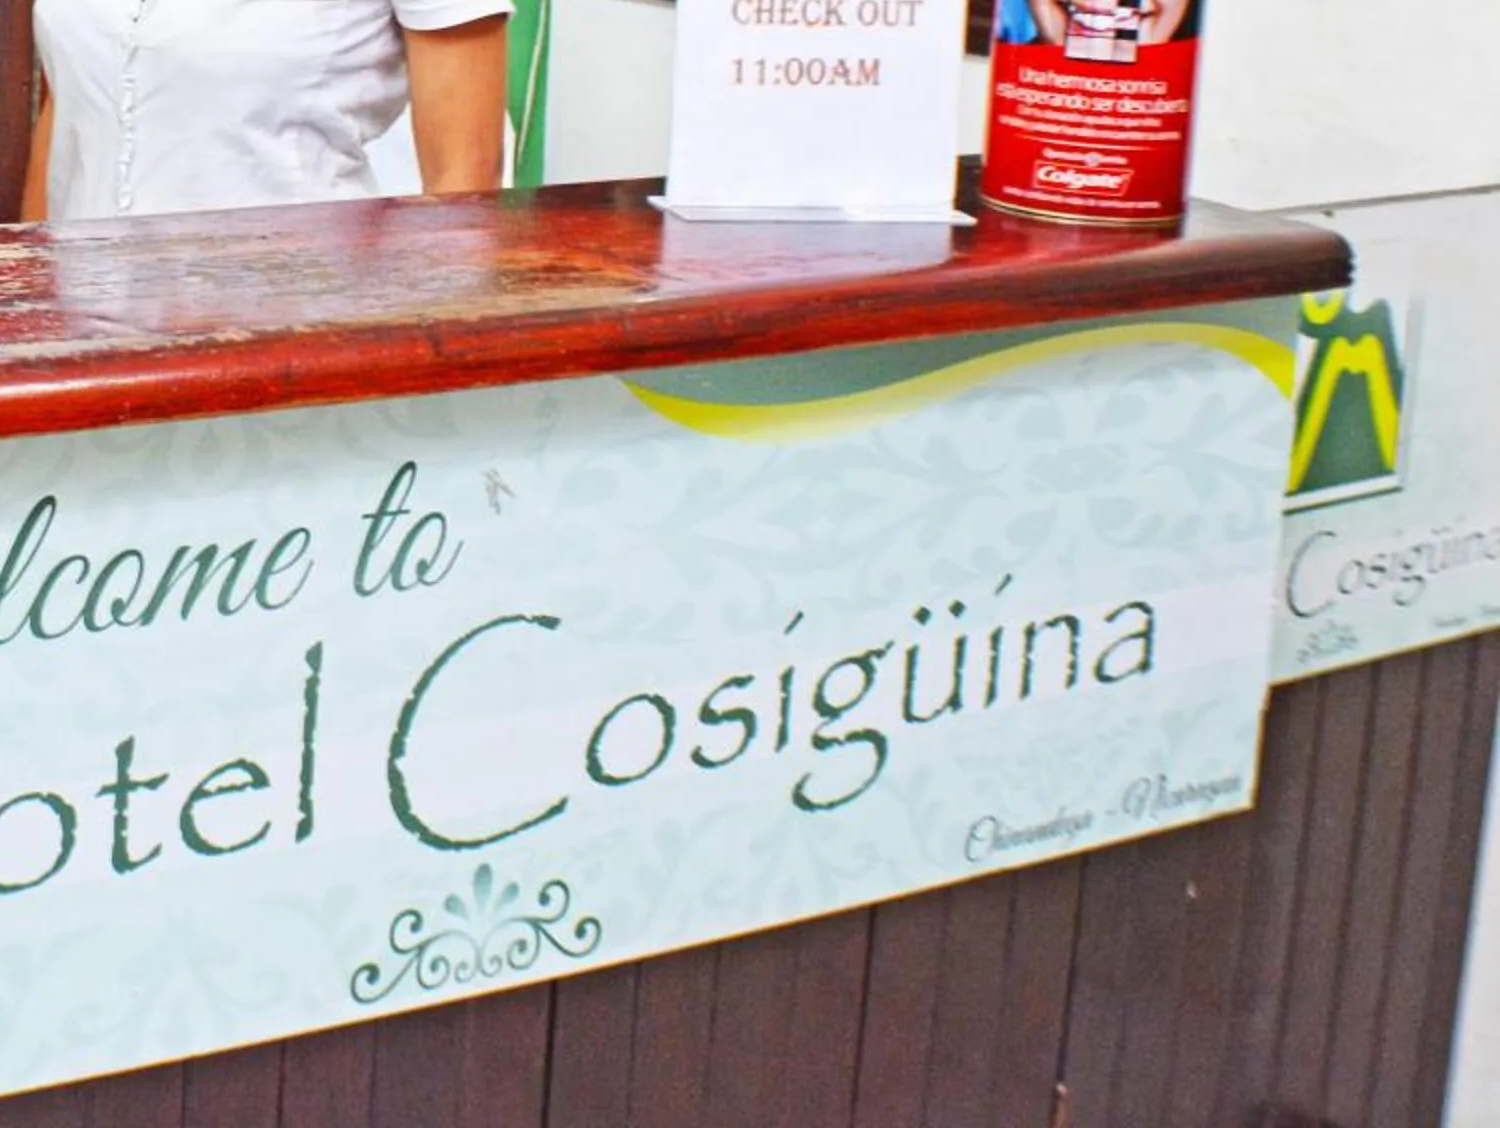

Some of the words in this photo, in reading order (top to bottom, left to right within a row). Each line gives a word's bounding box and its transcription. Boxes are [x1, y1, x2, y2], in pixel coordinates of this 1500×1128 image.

[857, 0, 924, 27] OUT
[731, 58, 882, 86] 11:00AM
[1038, 166, 1124, 189] Colgate
[352, 460, 463, 598] to
